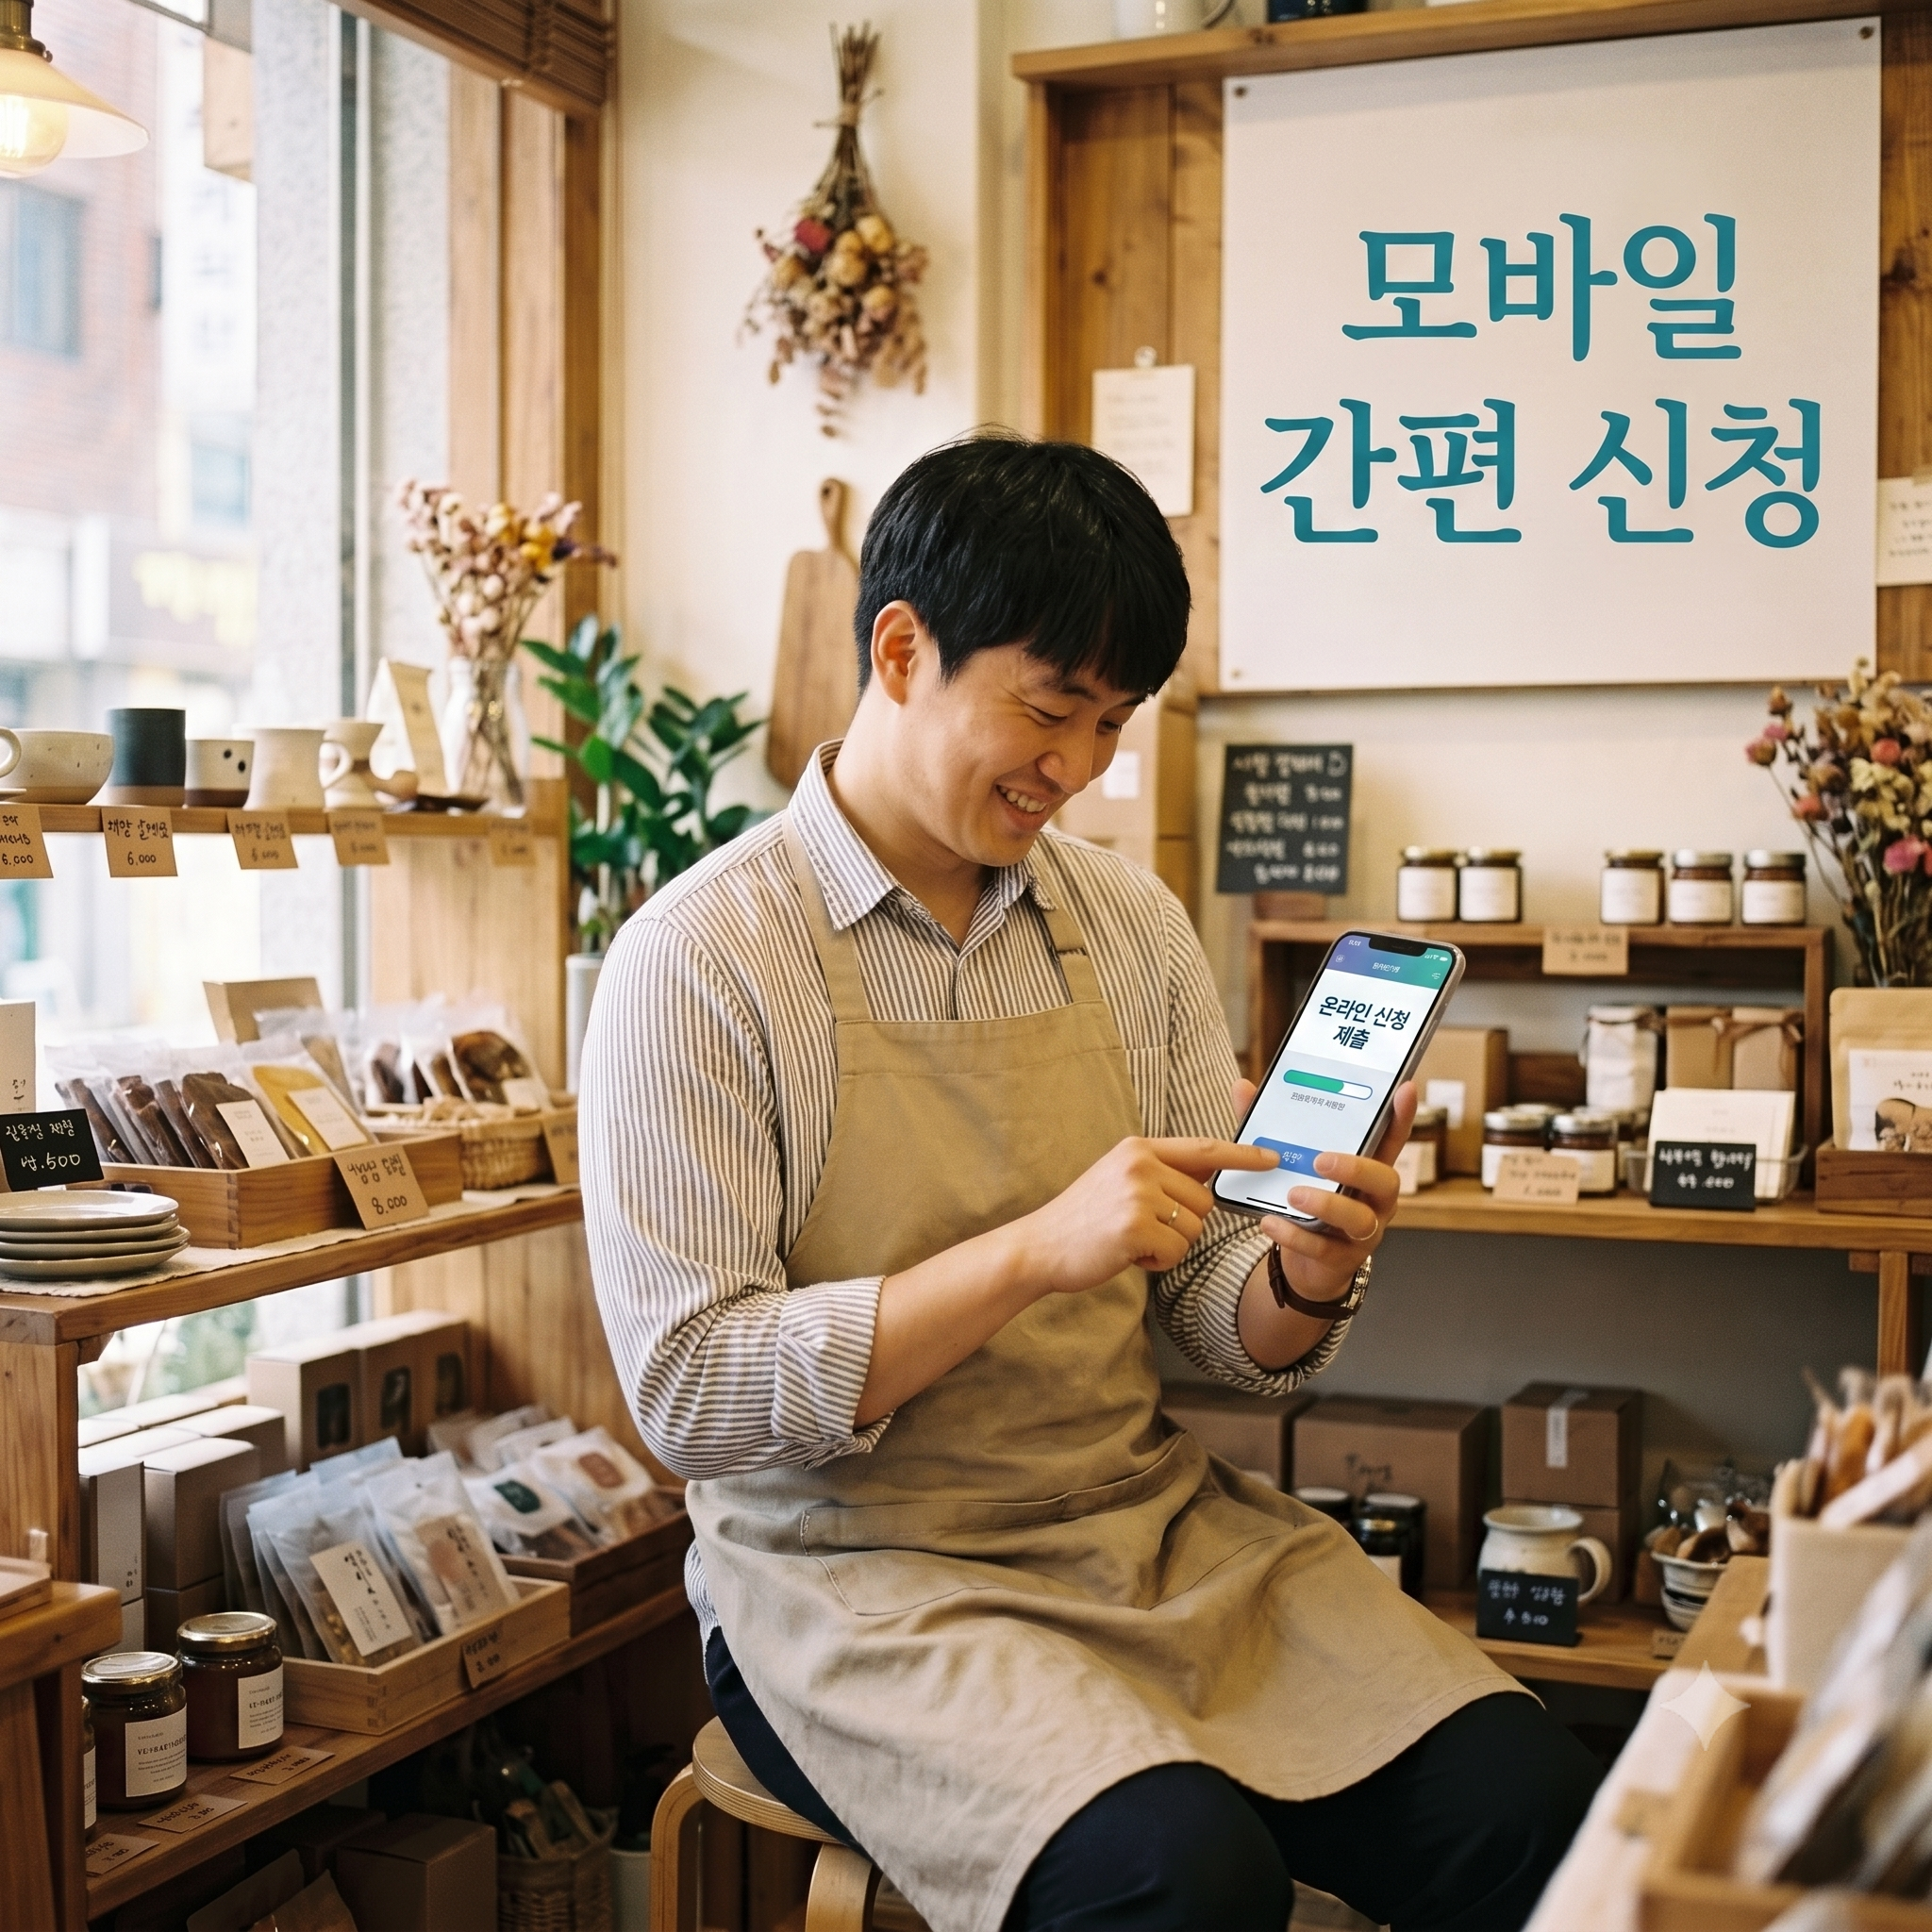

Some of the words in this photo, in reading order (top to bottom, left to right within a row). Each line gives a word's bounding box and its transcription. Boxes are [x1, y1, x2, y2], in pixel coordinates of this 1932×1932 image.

[1342, 213, 1741, 361] 모바일
[1260, 398, 1522, 542] 간편
[1570, 398, 1821, 548] 신청
[1319, 996, 1374, 1023] 온라인
[1374, 1007, 1411, 1030] 신청
